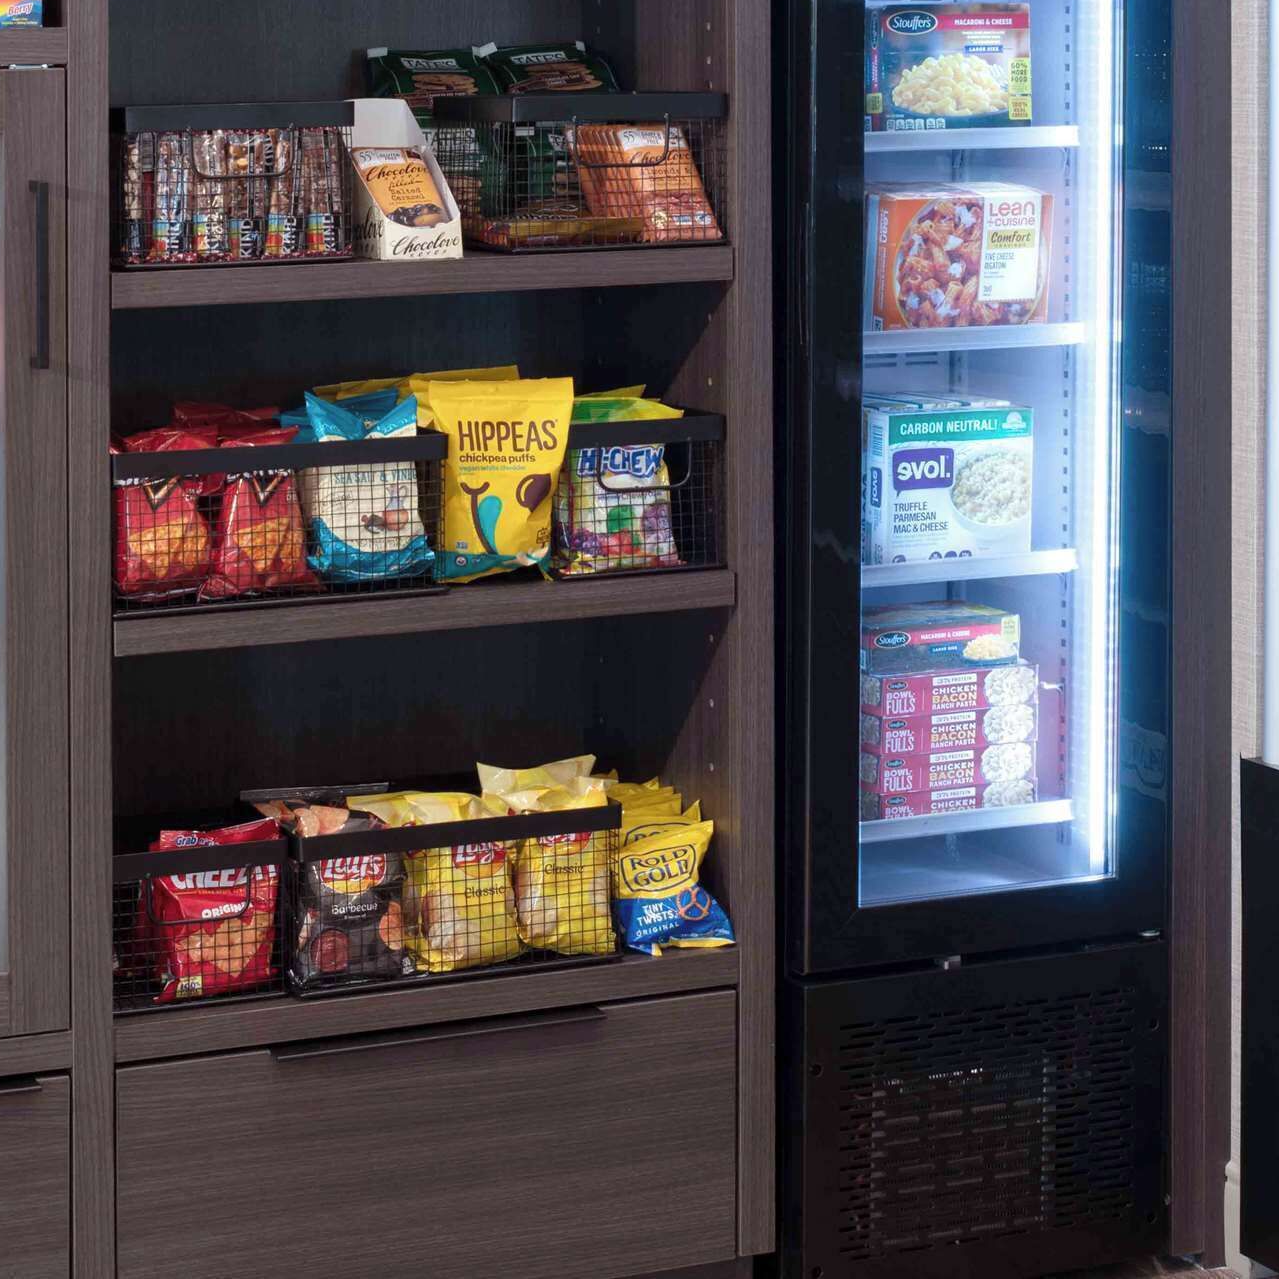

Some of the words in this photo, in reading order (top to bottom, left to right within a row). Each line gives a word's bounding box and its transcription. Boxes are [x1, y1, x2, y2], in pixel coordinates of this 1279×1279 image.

[892, 16, 932, 31] Stouffer's
[954, 18, 984, 26] MACARONI
[989, 201, 1035, 216] Lean
[994, 217, 1035, 226] cuisine
[393, 232, 459, 256] Chocolove
[991, 232, 1031, 244] Comfort
[900, 422, 943, 436] CARBON
[947, 419, 998, 433] NEUTRAL!
[457, 420, 557, 452] HIPPEAS
[459, 453, 506, 463] chickpea
[509, 453, 536, 462] puffs
[894, 502, 927, 512] TRUFFLE
[893, 512, 936, 523] PARMESAN
[893, 524, 911, 534] MAC
[912, 524, 918, 532] &
[920, 522, 949, 532] CHEESE
[921, 632, 946, 640] MACARONI
[932, 685, 977, 695] CHICKEN
[932, 693, 977, 704] BACON
[887, 699, 915, 715] FULLS
[932, 702, 955, 710] RANCH
[956, 700, 977, 708] PASTA
[930, 762, 974, 772] CHICKEN
[929, 771, 974, 781] BACON
[883, 776, 912, 792] FULLS
[929, 779, 952, 788] RANCH
[953, 777, 973, 785] PASTA
[175, 836, 196, 846] Grab
[629, 848, 688, 870] ROLD
[544, 863, 584, 875] Classic
[634, 859, 688, 887] GOLD
[465, 884, 505, 897] Classic
[332, 901, 378, 915] Barbecue
[642, 902, 664, 914] TINY
[636, 922, 680, 937] ORIGINAL
